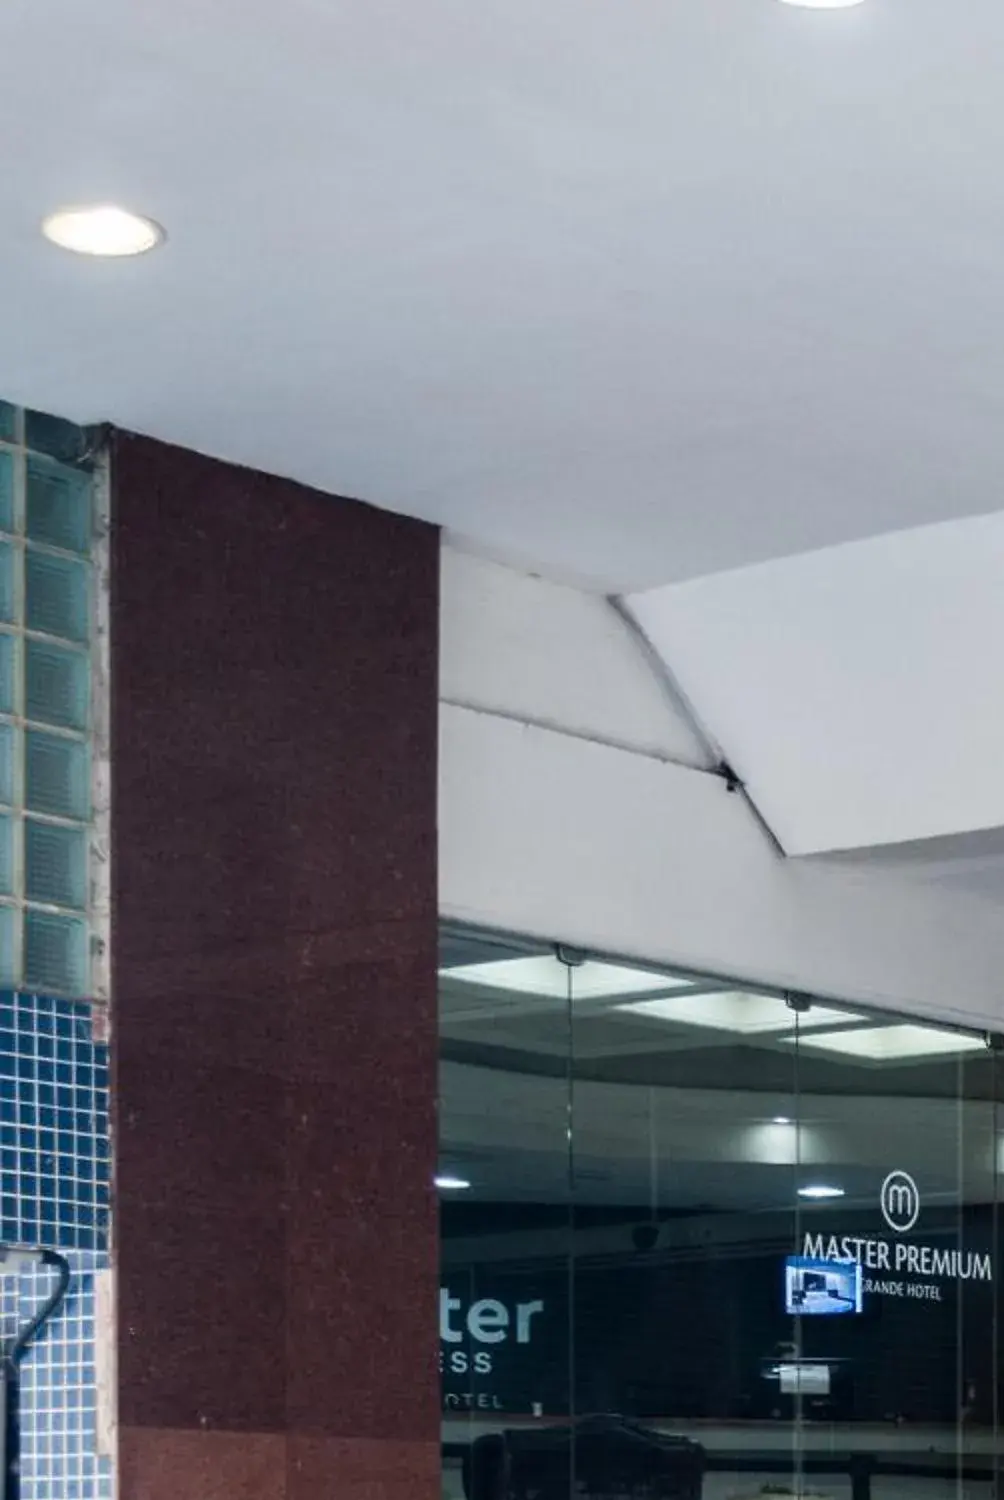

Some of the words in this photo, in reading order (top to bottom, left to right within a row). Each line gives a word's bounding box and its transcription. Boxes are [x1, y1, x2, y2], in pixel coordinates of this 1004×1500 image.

[803, 1232, 891, 1271] MASTER
[895, 1243, 993, 1281] PREMIUM
[907, 1283, 942, 1301] HOTEL
